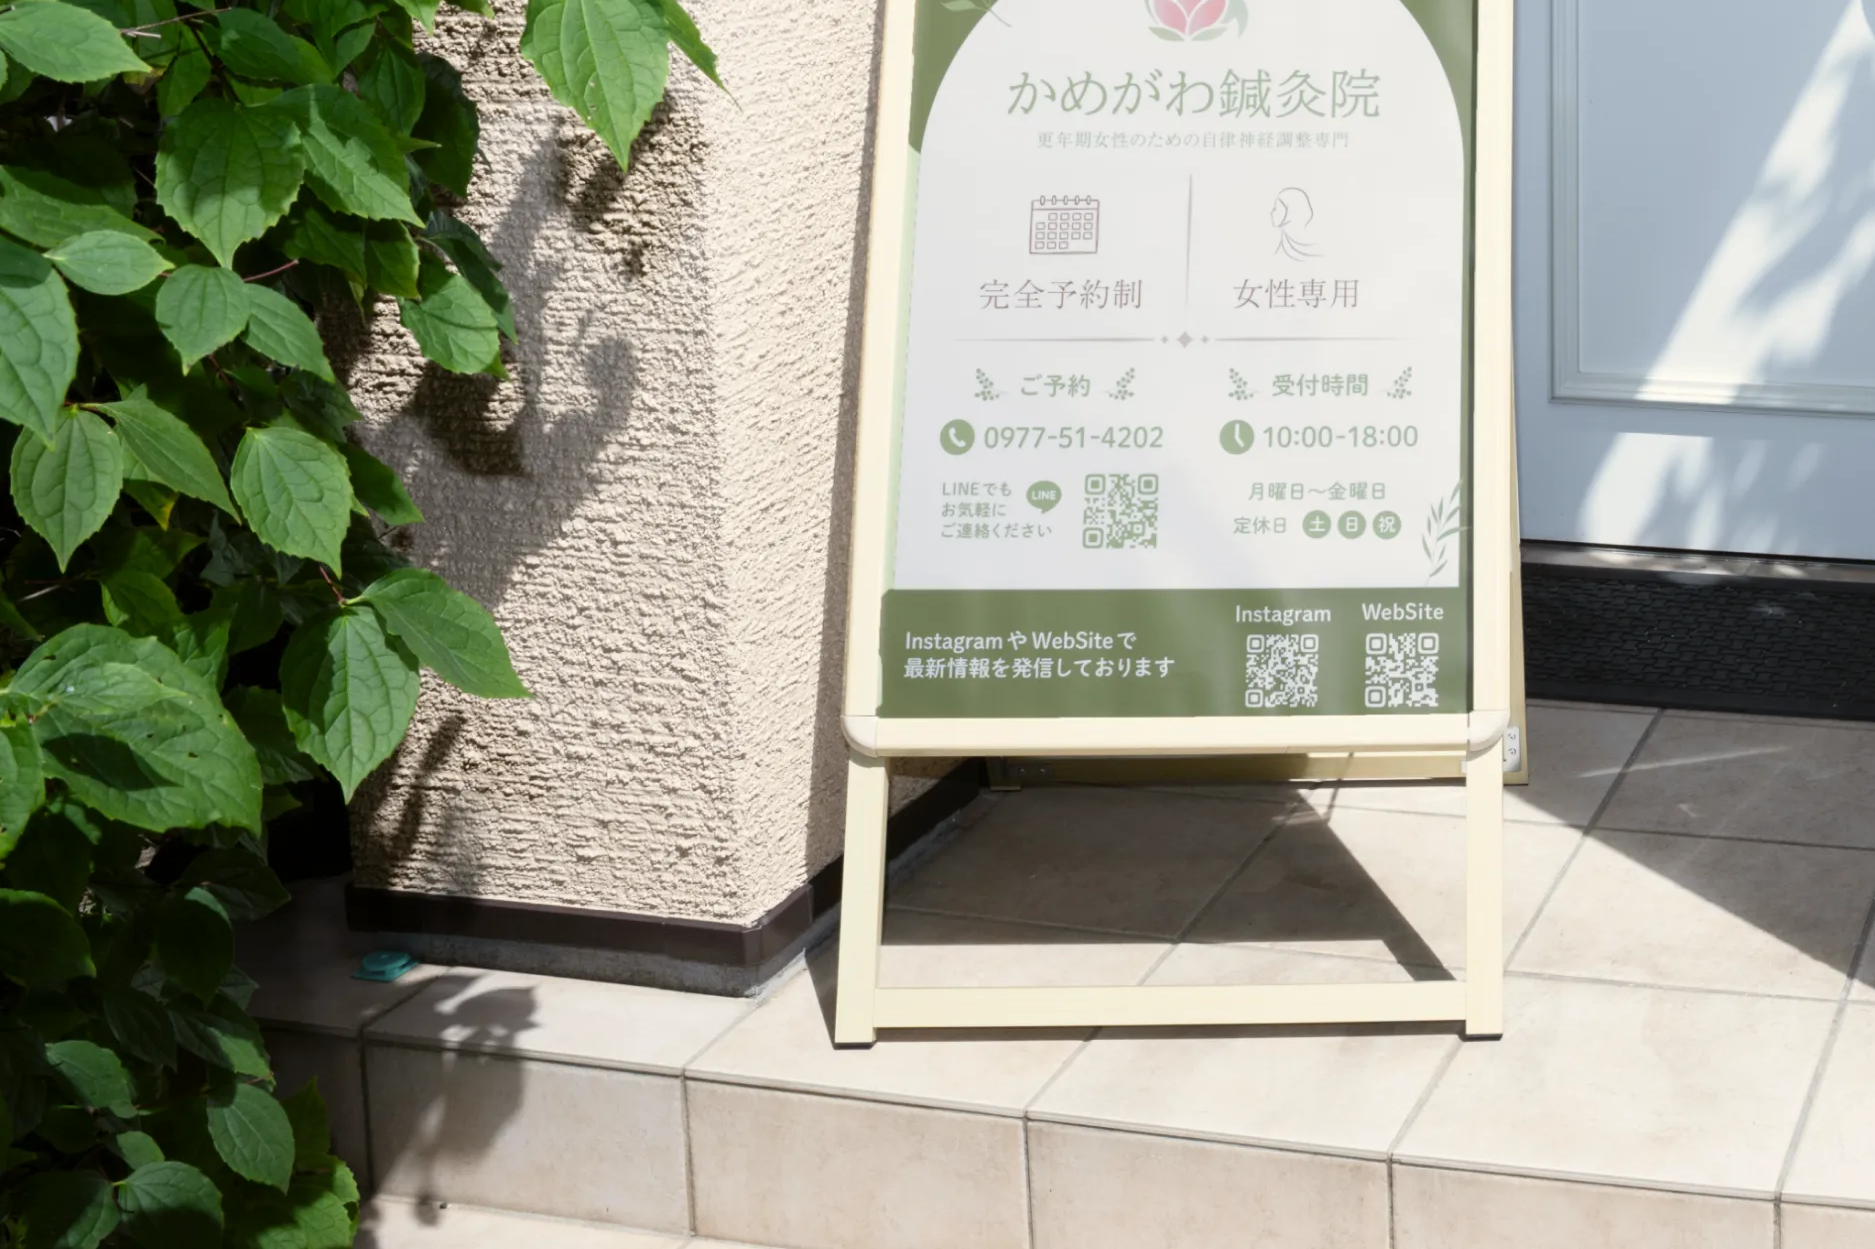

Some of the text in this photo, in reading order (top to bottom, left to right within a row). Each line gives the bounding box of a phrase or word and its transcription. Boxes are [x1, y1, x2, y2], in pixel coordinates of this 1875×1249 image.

[1007, 68, 1381, 119] かめがわ鍼灸院
[1036, 130, 1349, 149] 更年期女性のための自律神経調整専門
[979, 278, 1143, 310] 完全予約制
[1233, 278, 1359, 309] 女性専用
[1020, 373, 1091, 398] ご予約
[1272, 373, 1369, 397] 受付時間
[983, 426, 1164, 450] 0977-51-4202
[1262, 424, 1419, 449] 10:00-18:00
[1031, 489, 1057, 502] LINE
[941, 501, 1006, 518] お気軽に
[941, 522, 1053, 539] ご連絡ください
[1233, 516, 1396, 535] 定休日 土 日 祝
[1235, 605, 1332, 626] Instagram
[1361, 602, 1444, 621] WebSite
[903, 656, 1176, 679] 最新情報を発信しております
